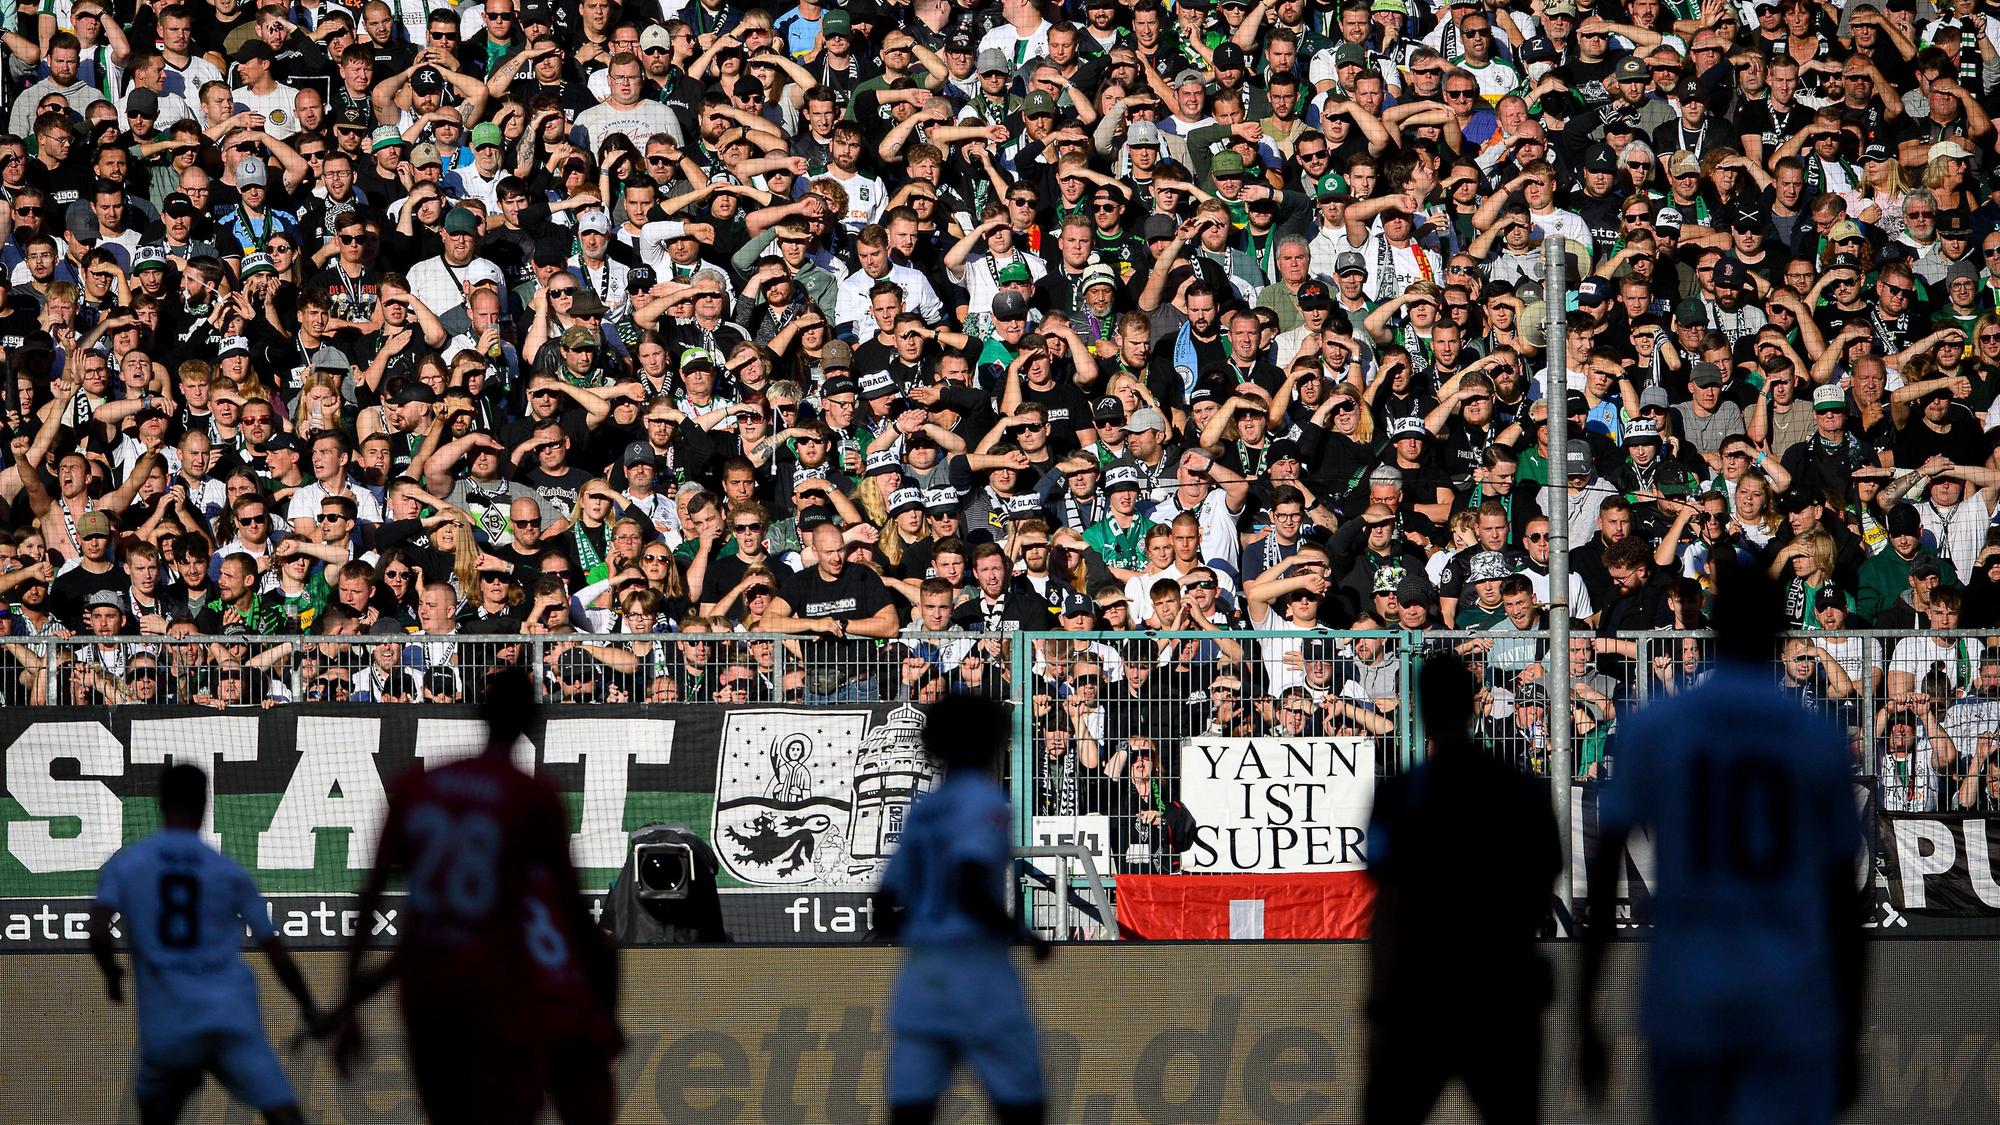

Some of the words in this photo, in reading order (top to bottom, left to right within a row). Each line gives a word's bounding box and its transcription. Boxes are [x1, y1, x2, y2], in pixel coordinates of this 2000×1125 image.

[1197, 739, 1362, 780] YANN
[5, 714, 675, 874] STAT
[1239, 782, 1327, 826] IST
[1192, 824, 1369, 870] SUPER
[160, 873, 198, 948] 8
